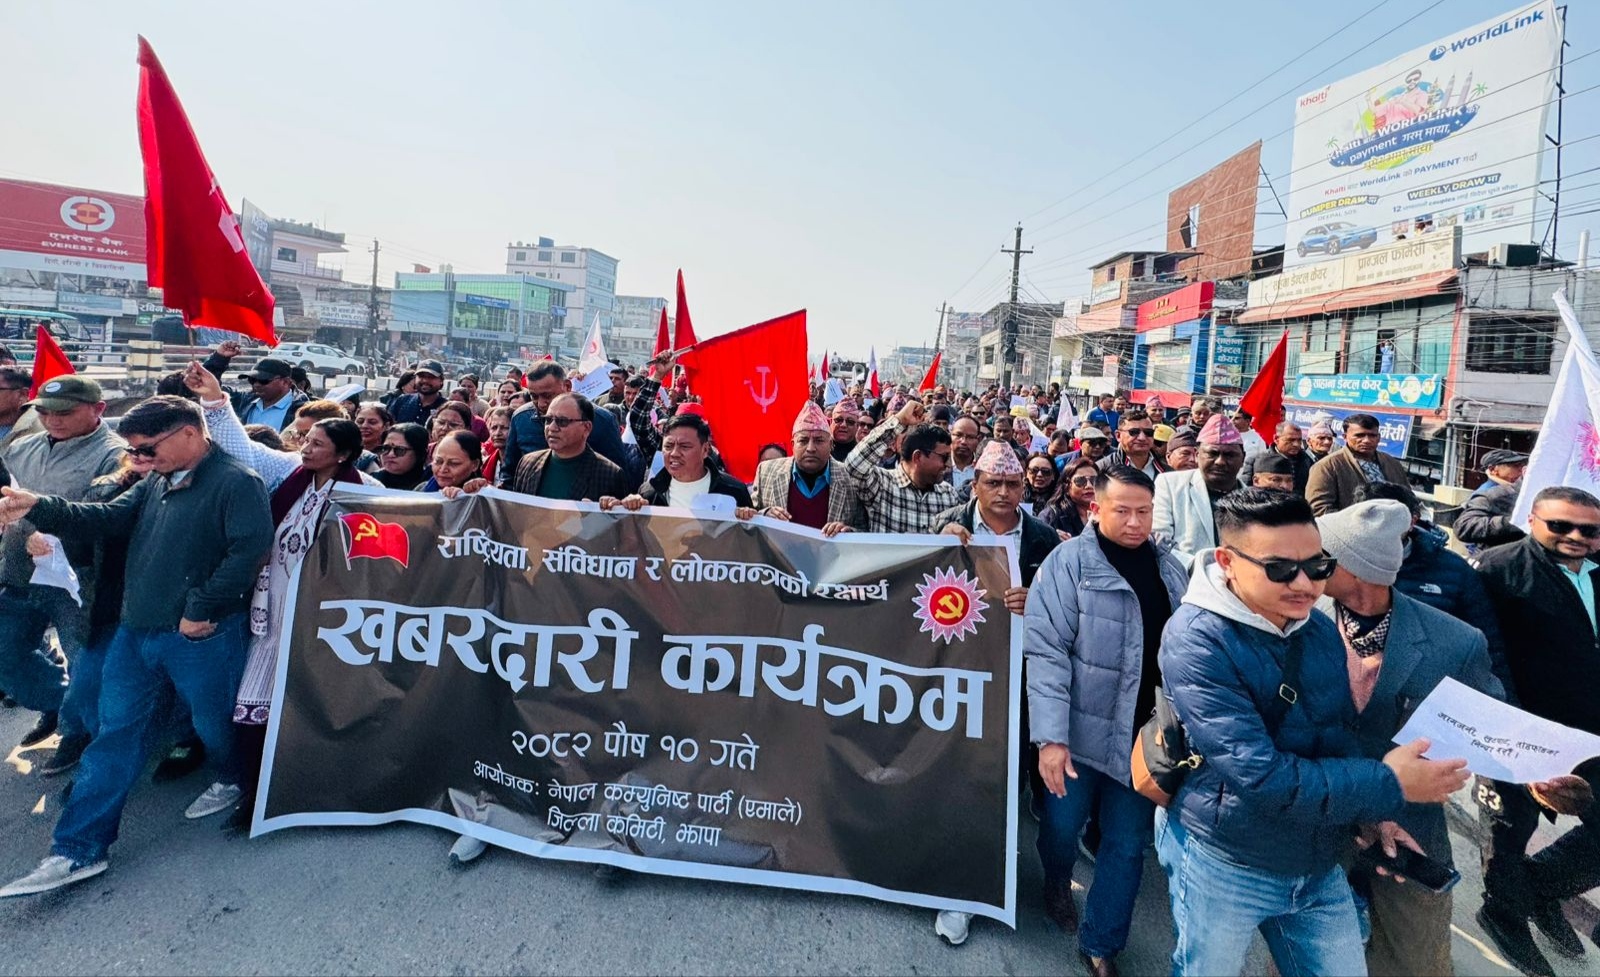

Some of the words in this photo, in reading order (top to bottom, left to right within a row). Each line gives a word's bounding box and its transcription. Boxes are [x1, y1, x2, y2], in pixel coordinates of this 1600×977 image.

[1450, 9, 1544, 54] WorldLink
[1349, 136, 1397, 164] payment
[1360, 173, 1401, 188] WorldLink
[1414, 157, 1461, 175] PAYMENT
[1408, 184, 1450, 200] WEEKLY
[1451, 177, 1486, 192] DRAW
[1301, 200, 1337, 218] BUMPER
[1338, 195, 1368, 207] DRAW
[41, 240, 94, 252] EVEREST
[96, 247, 129, 256] BANK
[542, 545, 638, 580] संविधान
[646, 557, 664, 581] र
[671, 553, 809, 598] लोकतन्त्रको
[813, 579, 889, 602] रक्षार्थ
[317, 599, 639, 693] खबरदारी
[661, 623, 993, 739] कार्यक्रम
[512, 730, 592, 758] २०८२
[604, 721, 650, 758] पौष
[660, 735, 699, 763] १०
[710, 733, 760, 771] गते
[473, 760, 540, 796] आयोजक:
[548, 779, 598, 802] नेपाल
[604, 783, 692, 812] कम्युनिष्ट
[698, 790, 734, 815] पार्टी
[738, 795, 802, 826] (एमाले)
[547, 806, 601, 832] जिल्ला
[606, 813, 666, 844] कमिटी,
[675, 823, 722, 847] झापा
